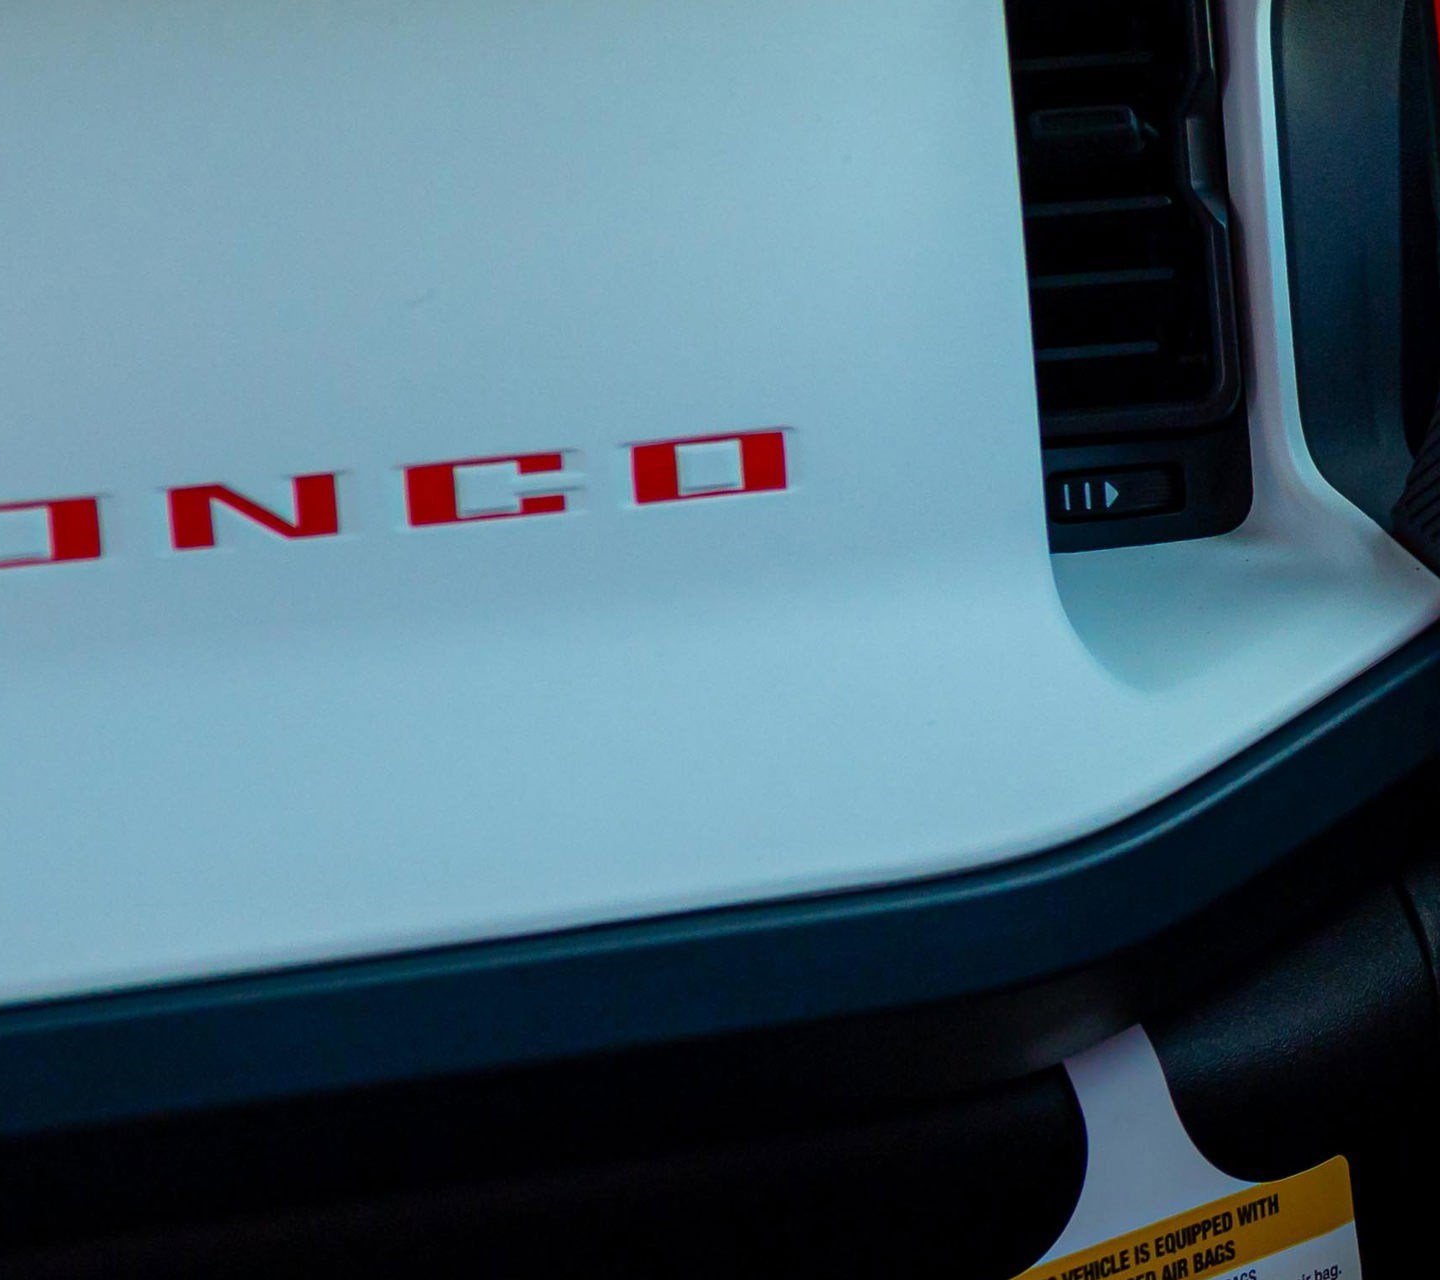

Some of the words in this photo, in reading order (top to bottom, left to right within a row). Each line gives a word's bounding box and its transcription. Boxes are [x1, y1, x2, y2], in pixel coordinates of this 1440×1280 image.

[1134, 1242, 1150, 1265] IS
[1154, 1211, 1233, 1258] EQUIPPED
[1237, 1193, 1279, 1227] WITH
[1193, 1240, 1236, 1276] BAGS
